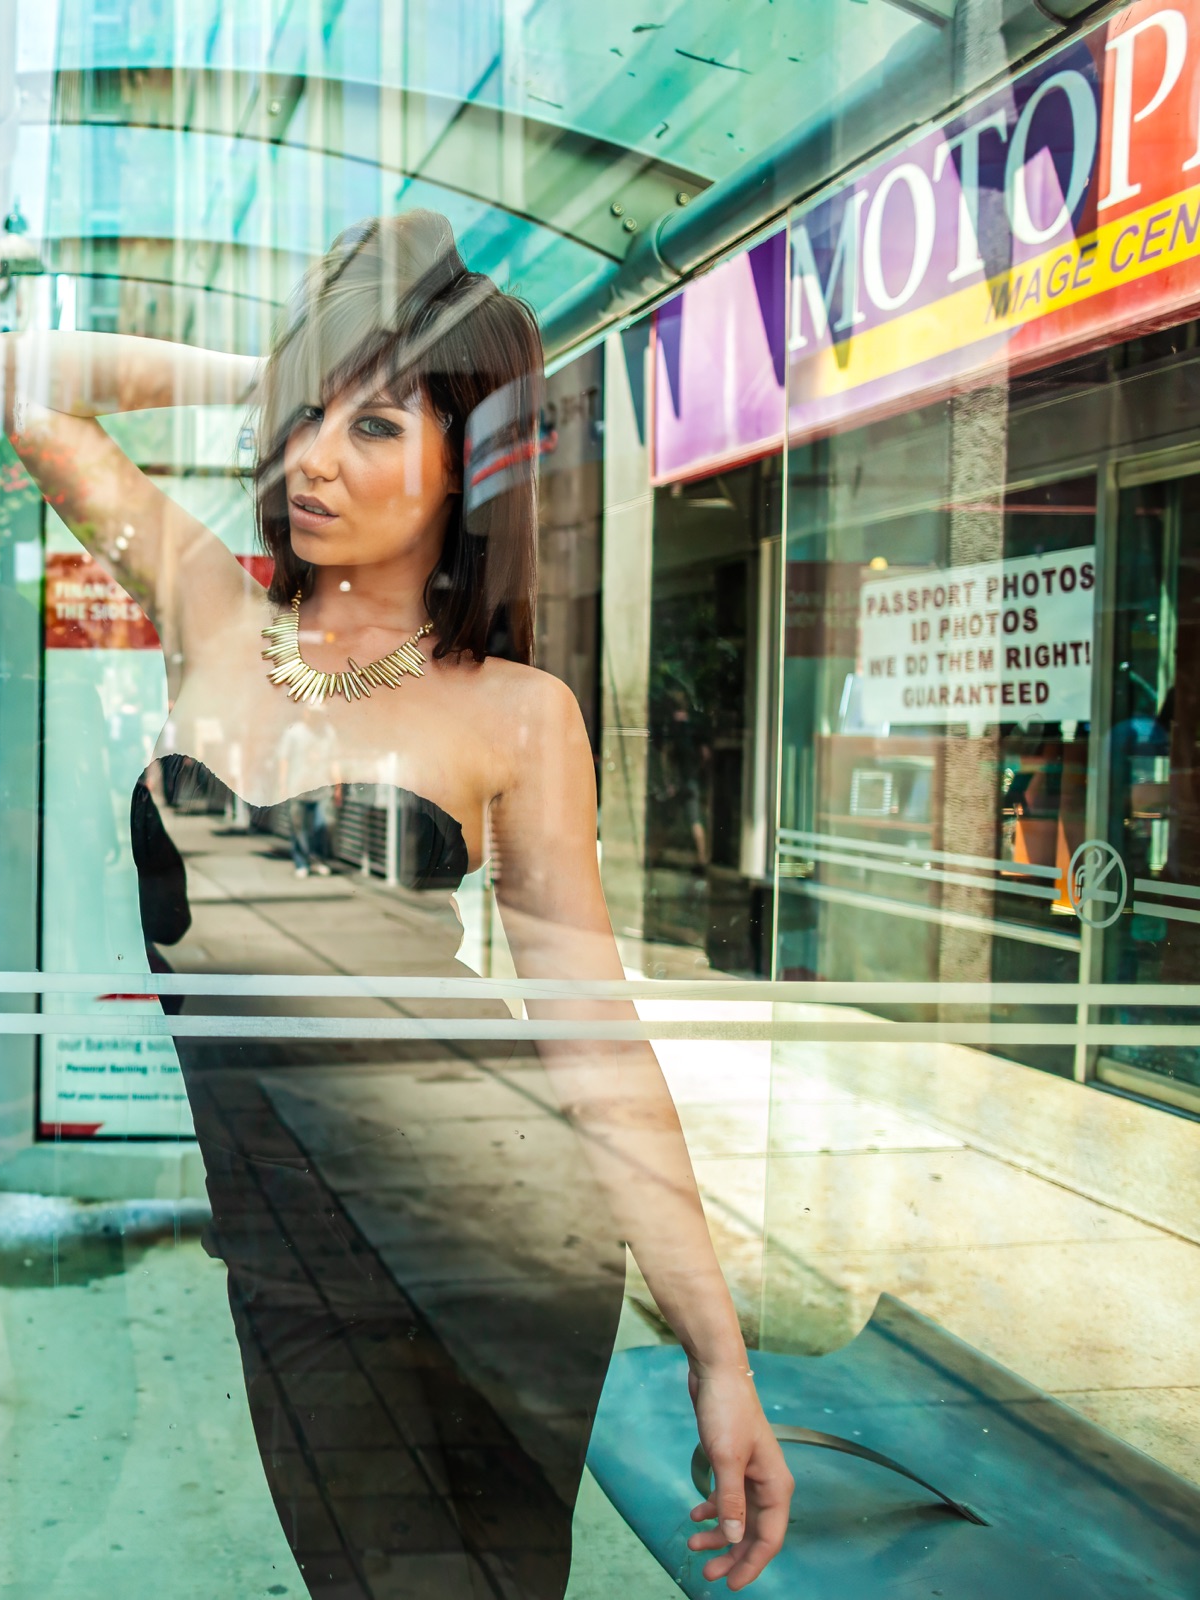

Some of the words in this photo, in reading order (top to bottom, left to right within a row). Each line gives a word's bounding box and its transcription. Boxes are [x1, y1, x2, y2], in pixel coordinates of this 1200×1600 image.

[788, 9, 1200, 352] MOTOP
[985, 241, 1099, 324] IMAGE
[866, 581, 975, 616] PASSPORT
[986, 562, 1096, 603] PHOTOS
[911, 620, 930, 643] ID
[939, 607, 1038, 639] PHOTOS
[869, 656, 896, 678] WE
[905, 653, 928, 676] DO
[937, 648, 995, 673] THEM
[1006, 641, 1092, 669] RIGHT!
[902, 681, 1049, 709] GUARANTEED
